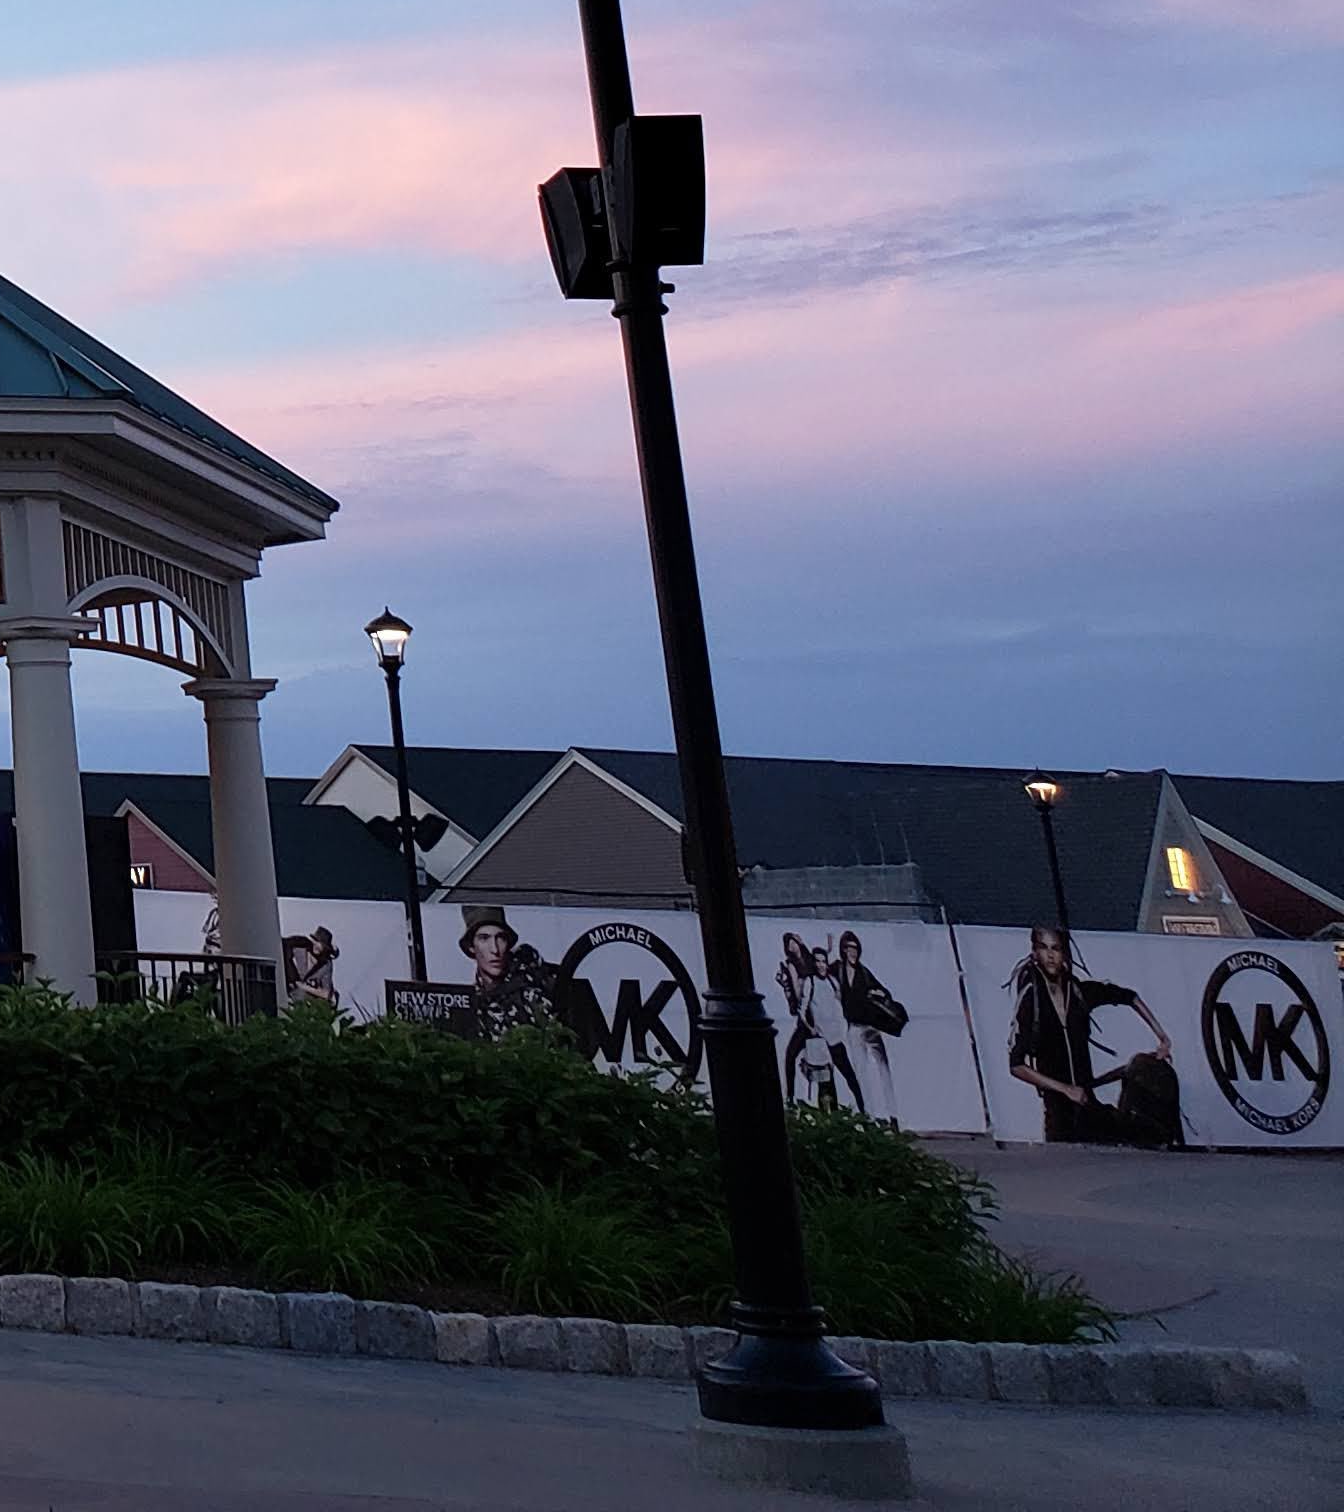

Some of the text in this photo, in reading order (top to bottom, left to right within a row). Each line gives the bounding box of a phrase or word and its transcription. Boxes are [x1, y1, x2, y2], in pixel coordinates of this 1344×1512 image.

[588, 926, 652, 949] MICHAEL
[1226, 954, 1281, 975] MICHAEL
[394, 990, 470, 1009] NEW STORE
[567, 978, 691, 1064] MK
[1214, 1002, 1320, 1082] MK
[1235, 1096, 1320, 1133] MICHAEL KORS
